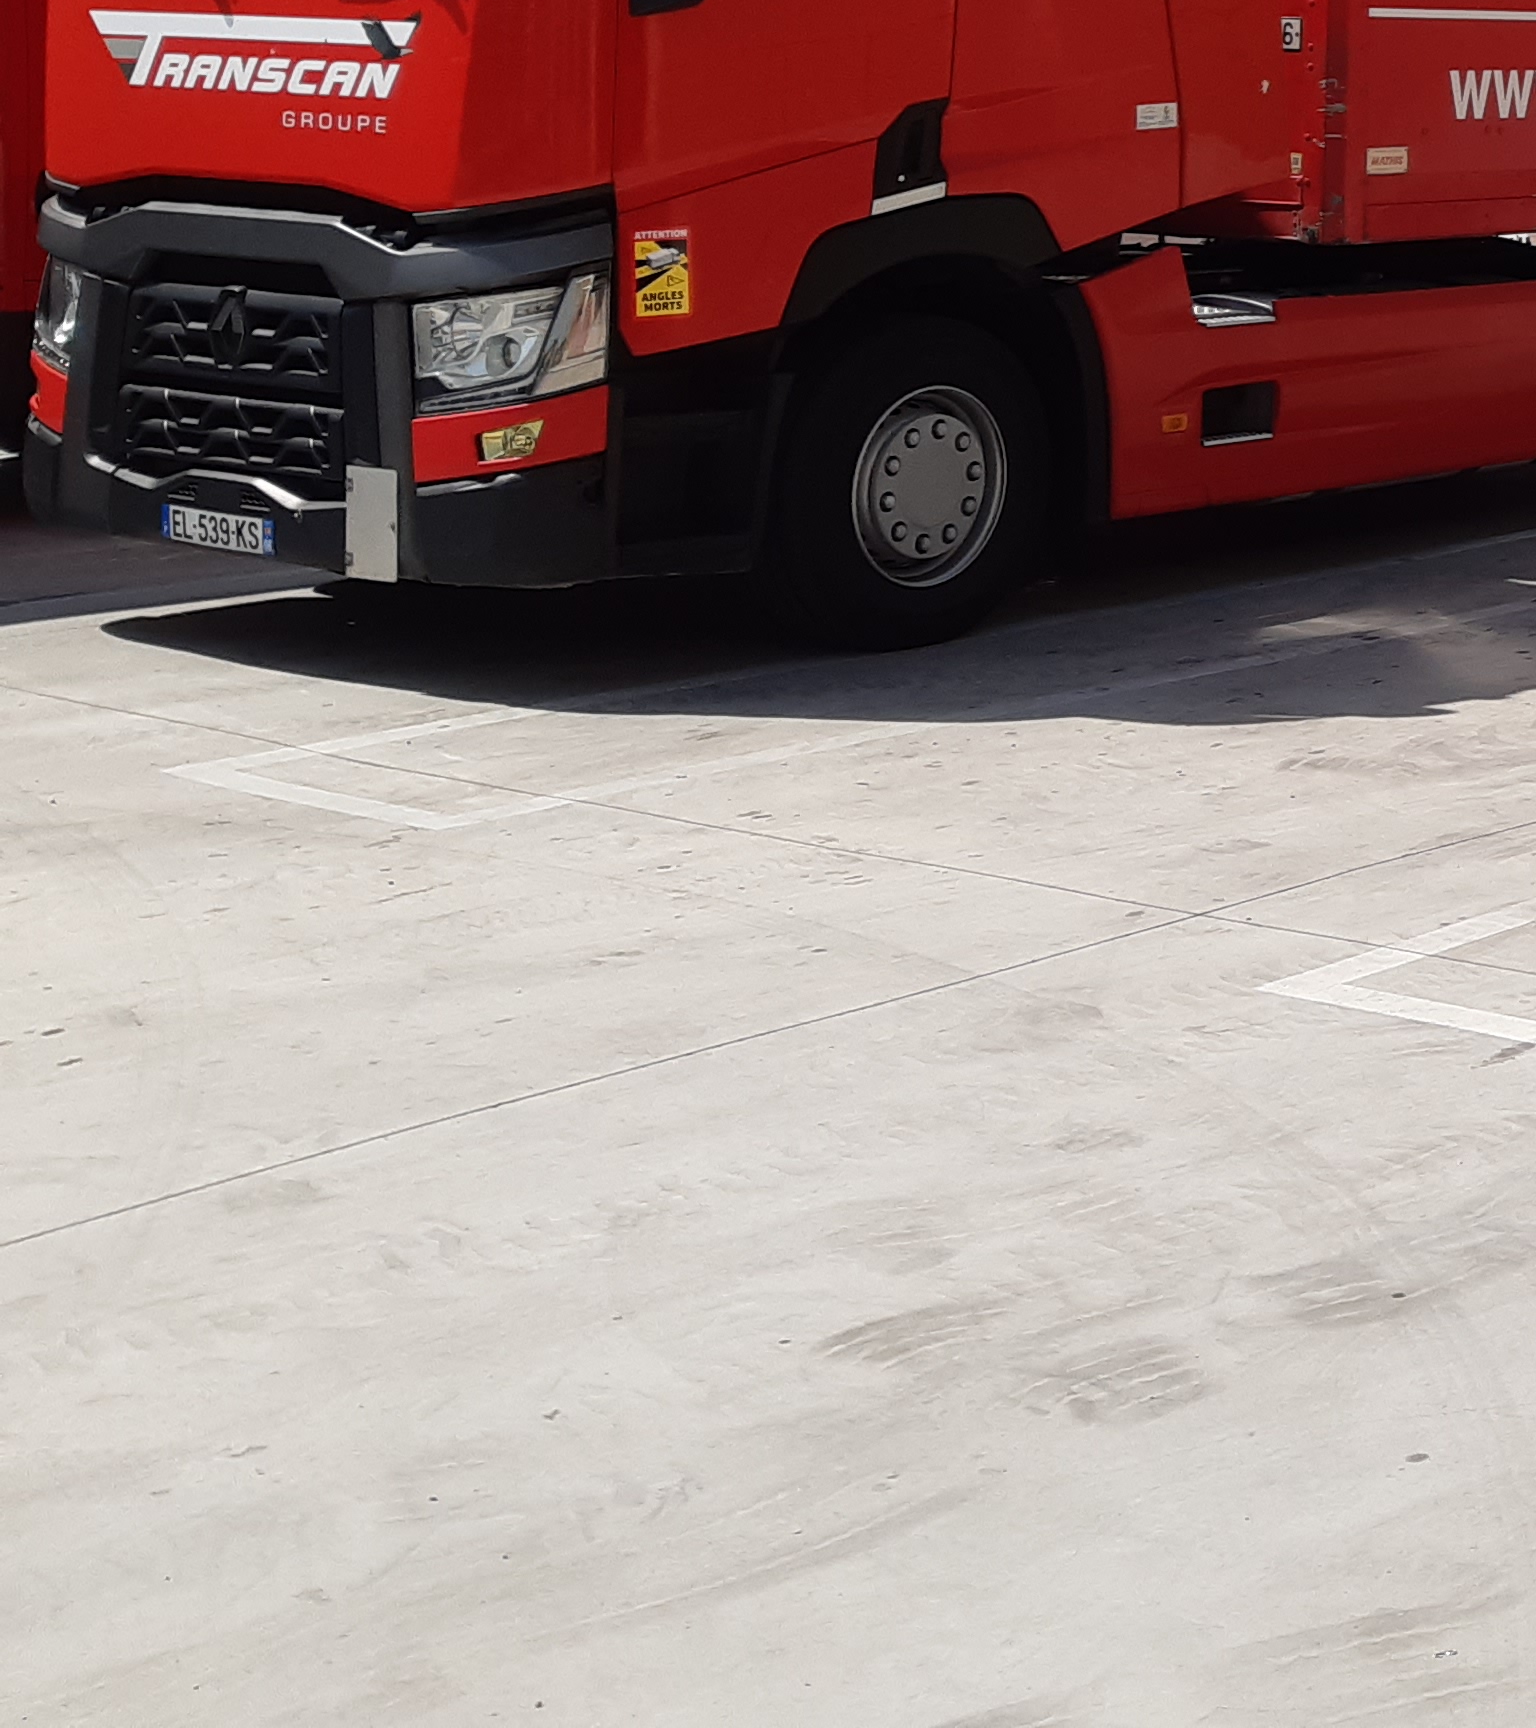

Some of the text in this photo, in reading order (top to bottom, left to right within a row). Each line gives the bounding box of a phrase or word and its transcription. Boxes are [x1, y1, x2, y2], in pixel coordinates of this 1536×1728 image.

[89, 10, 417, 98] TRANSCAN
[282, 110, 387, 134] GROUPE
[634, 229, 688, 240] ATTENTION
[642, 291, 684, 302] ANGLES
[644, 301, 682, 312] MORTS
[172, 509, 260, 550] EL-539-KS
